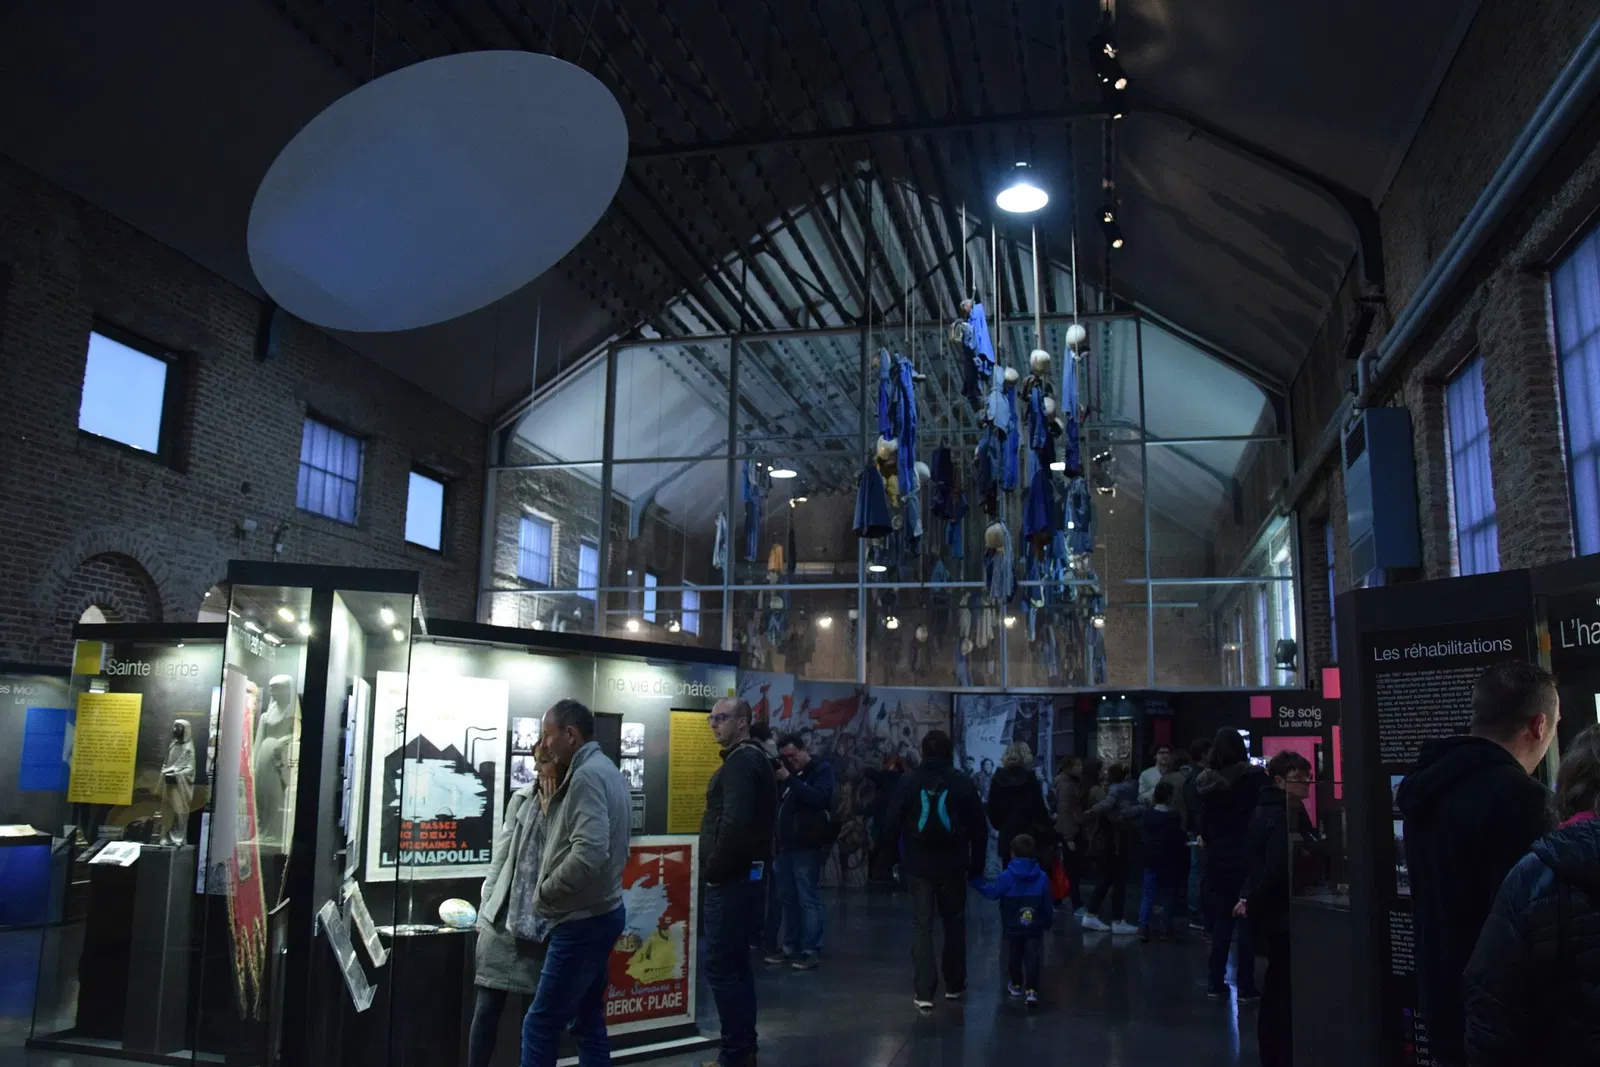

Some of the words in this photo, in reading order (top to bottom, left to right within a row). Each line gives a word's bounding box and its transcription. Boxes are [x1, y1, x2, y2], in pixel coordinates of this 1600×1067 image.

[1374, 646, 1400, 661] Les
[1404, 637, 1513, 659] réhabilitations
[106, 658, 151, 676] Sainte
[597, 675, 625, 692] ne
[629, 678, 649, 693] vie
[653, 678, 669, 694] de
[676, 680, 723, 698] châtea
[1279, 706, 1295, 718] Se
[1279, 719, 1289, 728] La
[1291, 719, 1313, 728] santé
[420, 831, 457, 840] DEUX
[414, 849, 490, 864] NAPOULE
[607, 983, 626, 998] Une
[606, 991, 683, 1017] BERCK-PLAGE
